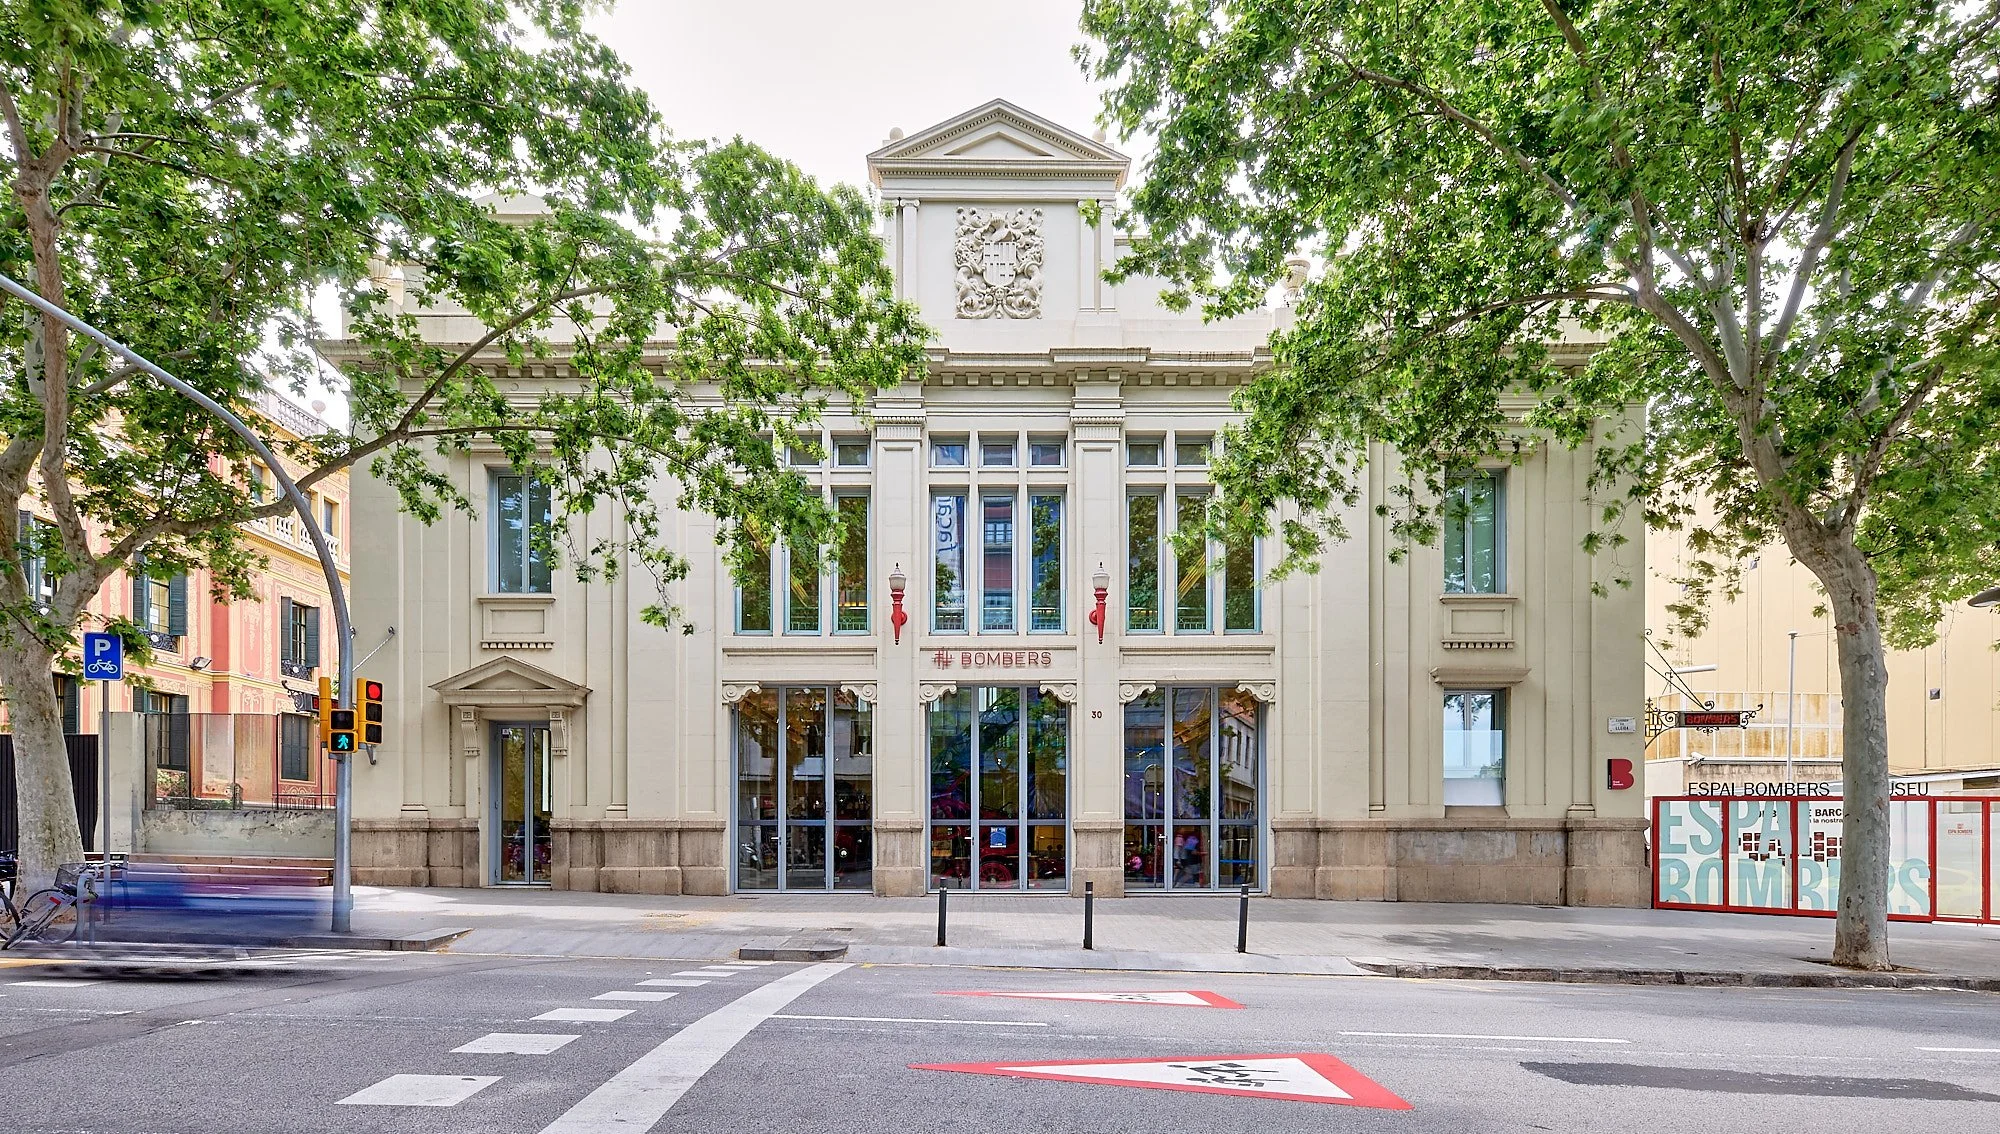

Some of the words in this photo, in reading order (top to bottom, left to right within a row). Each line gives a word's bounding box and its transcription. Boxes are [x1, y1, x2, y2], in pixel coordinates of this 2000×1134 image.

[94, 639, 111, 656] P
[961, 652, 1052, 666] BOMBERS
[1091, 711, 1103, 719] 30
[1686, 714, 1738, 724] BOMBERS
[1688, 782, 1735, 796] ESPAI
[1744, 782, 1830, 796] BOMBERS
[1815, 809, 1842, 817] BARC
[1660, 801, 1810, 855] ESPAI
[1660, 858, 1931, 914] BOMBS
